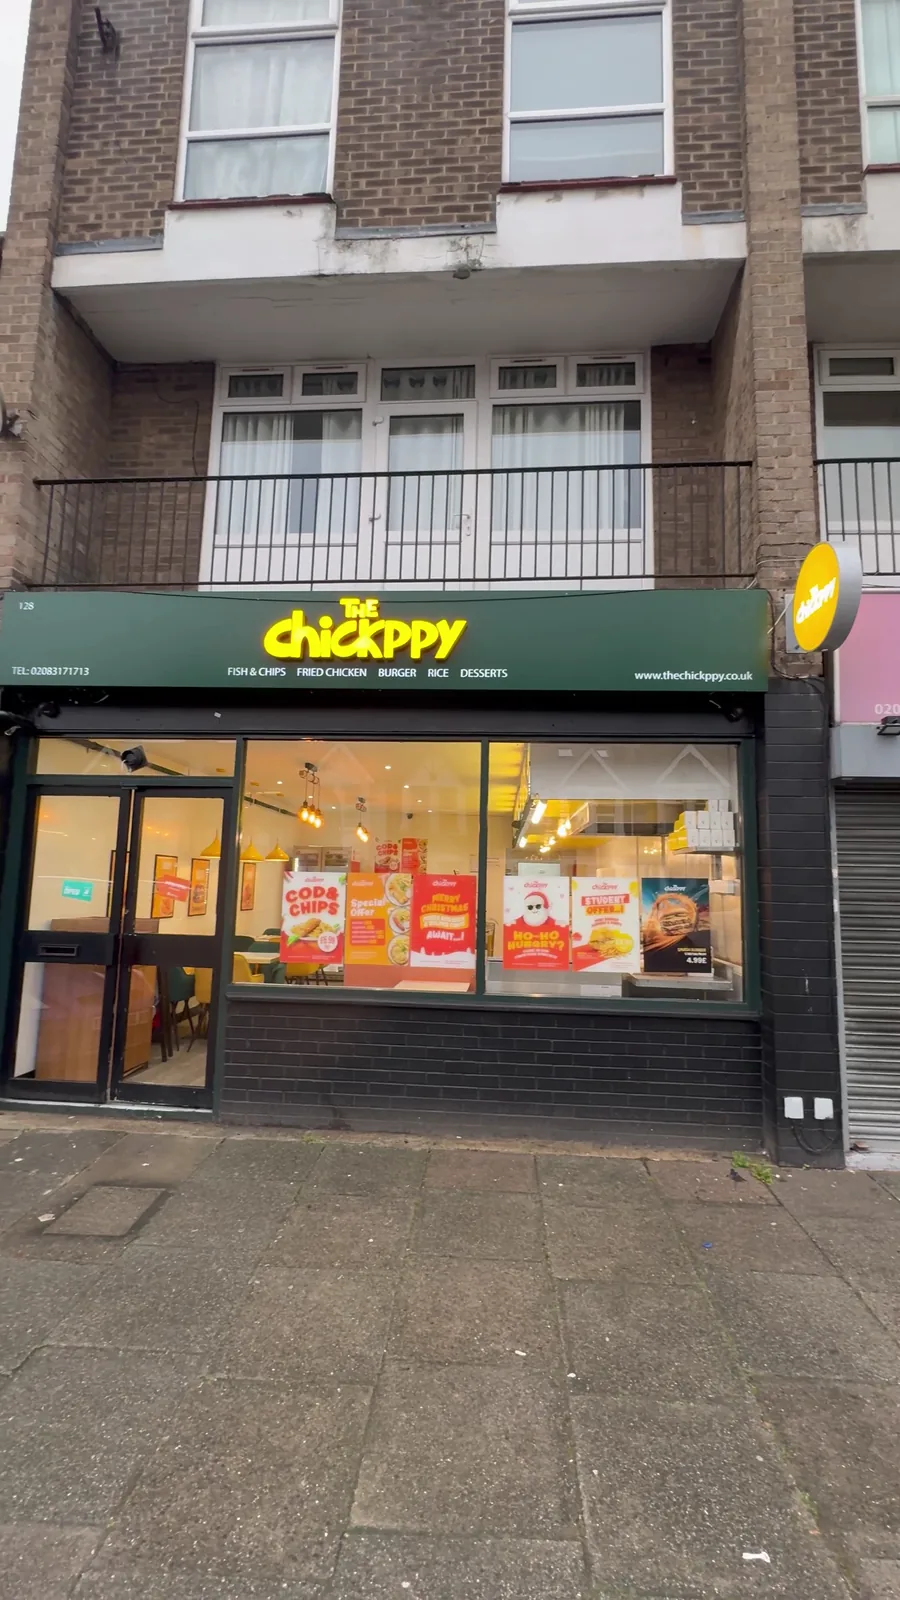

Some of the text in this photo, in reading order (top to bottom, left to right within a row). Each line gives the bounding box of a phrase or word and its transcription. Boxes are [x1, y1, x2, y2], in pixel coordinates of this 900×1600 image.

[19, 602, 35, 611] 128
[340, 598, 379, 618] THE
[12, 666, 90, 676] TEL: 02083171713
[227, 667, 509, 678] FISH & CHIPS FRIED CHICKEN BURGER RICE DESSERTS
[634, 670, 753, 682] www.thechickppy.co.uk
[351, 898, 385, 908] Special
[585, 895, 625, 905] STUDENT
[289, 900, 340, 917] CHIPS
[421, 903, 469, 913] CHRISTMAS
